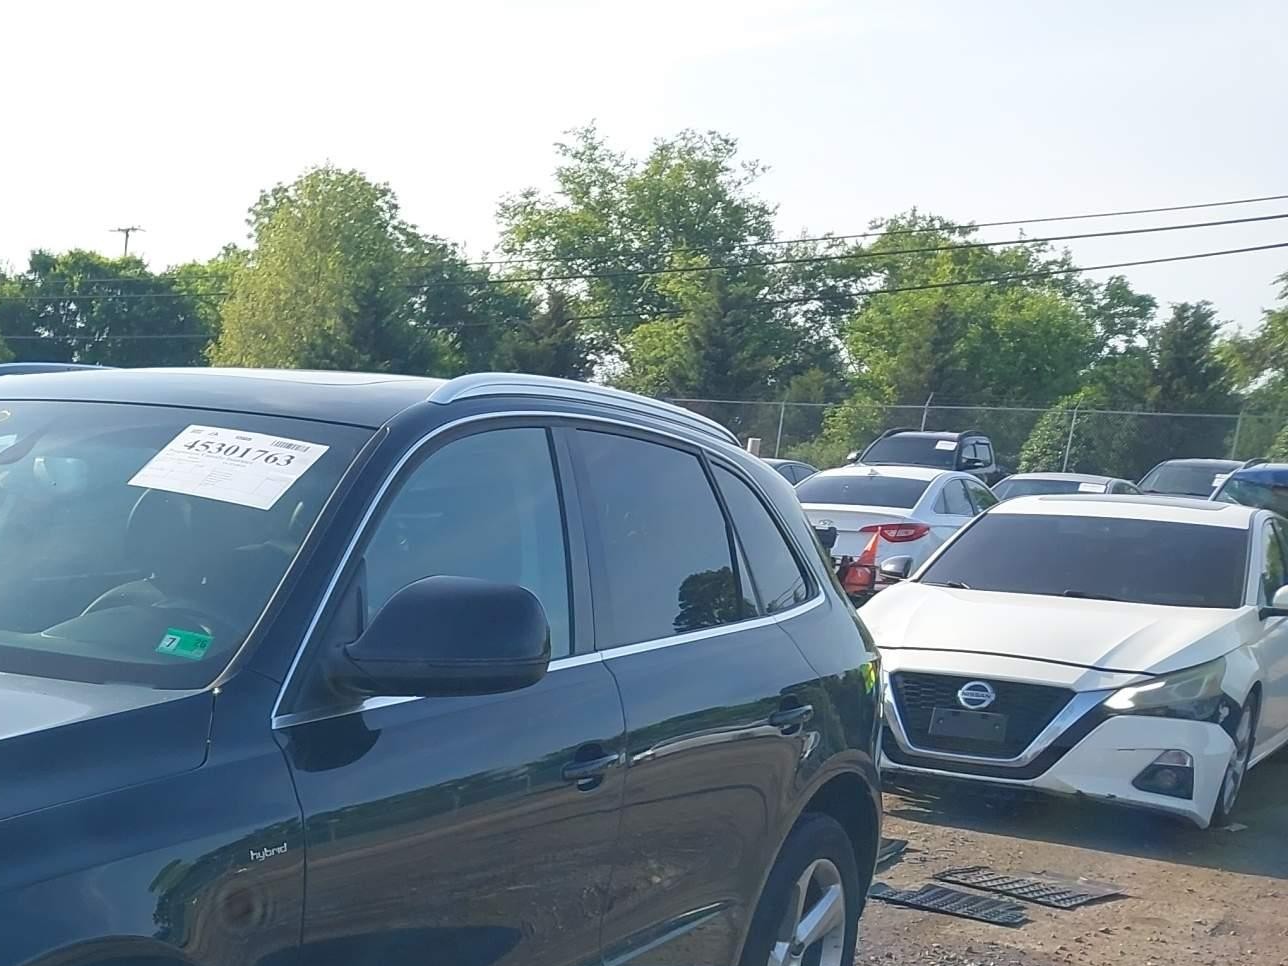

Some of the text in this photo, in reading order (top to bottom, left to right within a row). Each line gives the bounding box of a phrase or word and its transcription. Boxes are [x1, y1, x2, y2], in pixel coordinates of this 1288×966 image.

[184, 439, 296, 467] 45301763
[166, 637, 177, 648] 7
[250, 842, 288, 861] hybrid
